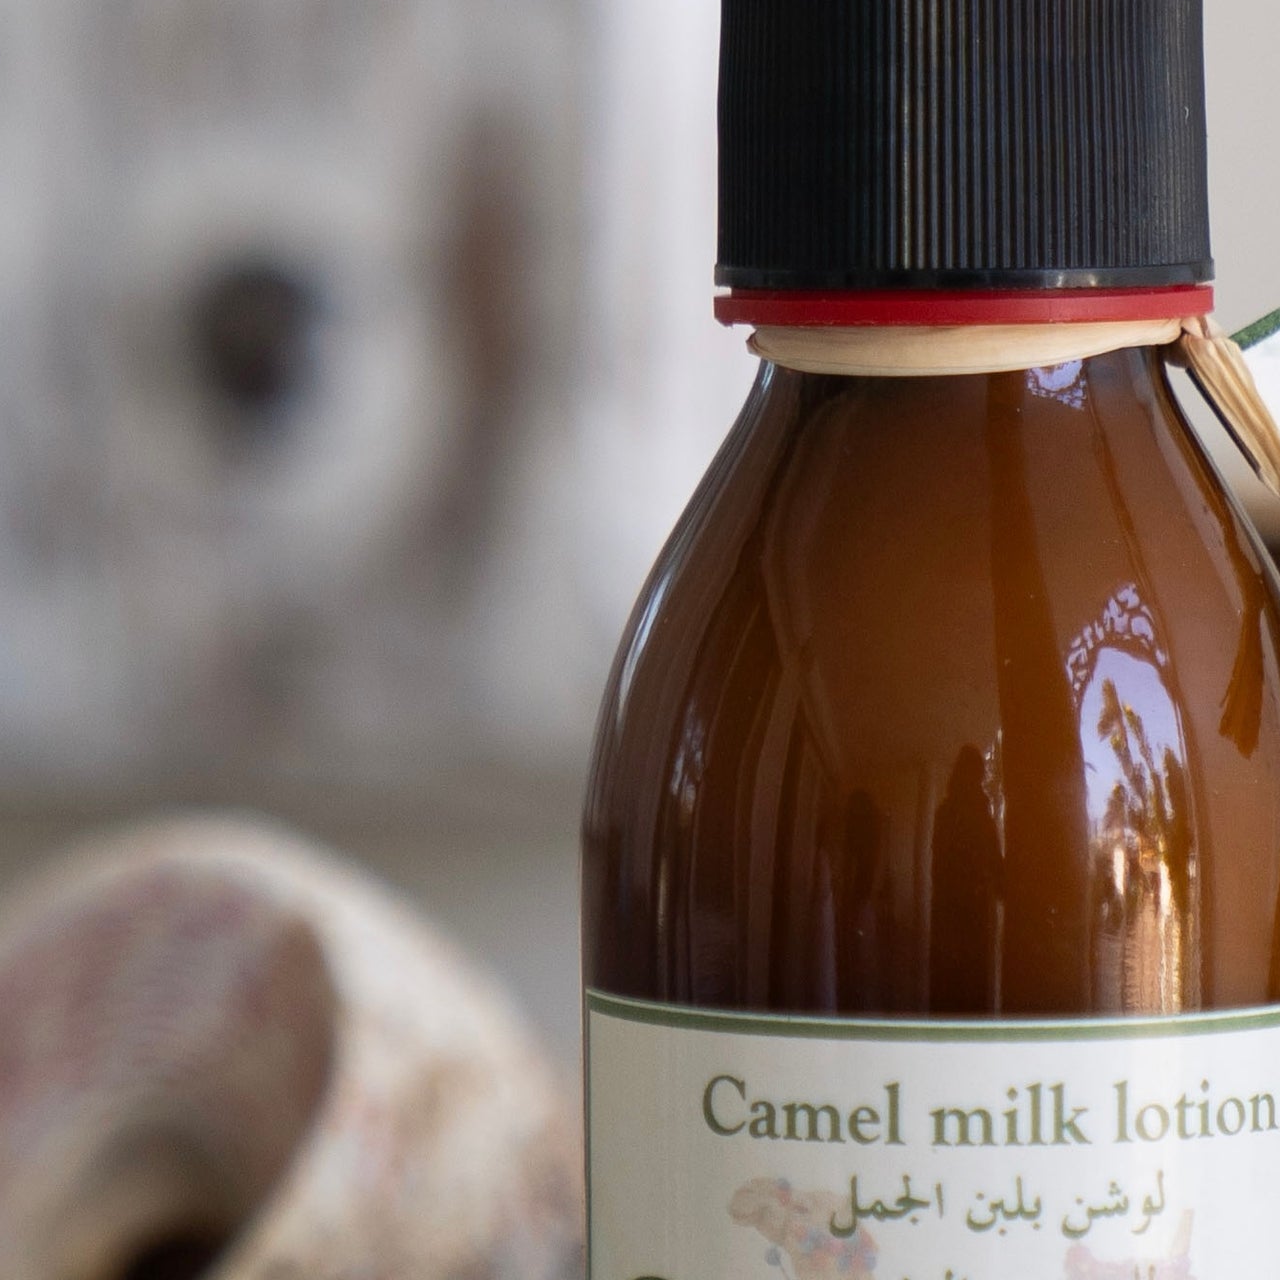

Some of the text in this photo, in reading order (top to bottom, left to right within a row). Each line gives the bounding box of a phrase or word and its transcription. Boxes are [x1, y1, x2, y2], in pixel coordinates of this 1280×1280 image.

[702, 1074, 1280, 1147] Camel milk lotion
[828, 1170, 1165, 1240] لوشن بلبن الجمل
